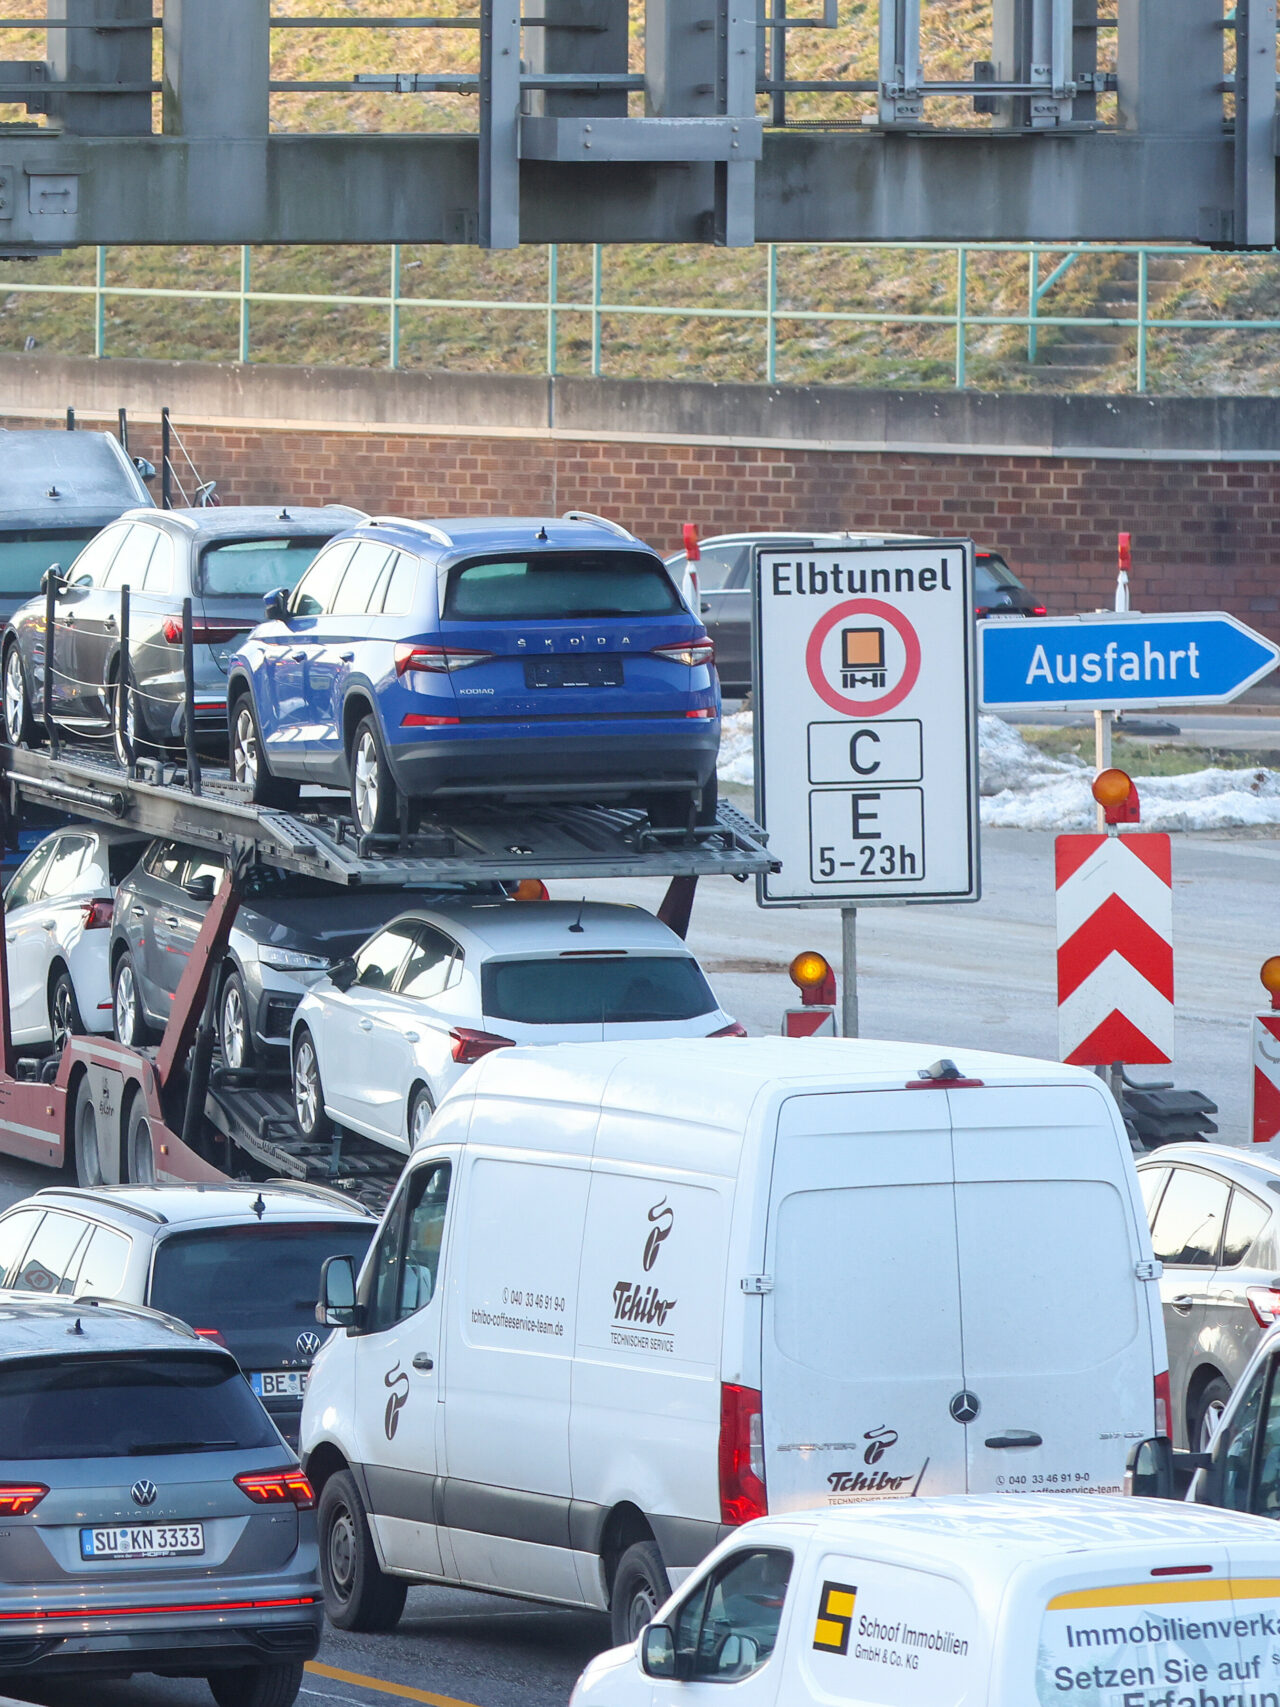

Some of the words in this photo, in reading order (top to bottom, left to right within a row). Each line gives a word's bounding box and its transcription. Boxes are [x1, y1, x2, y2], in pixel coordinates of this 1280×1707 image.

[772, 558, 951, 595] Elbtunnel
[1025, 640, 1200, 685] Ausfahrt
[459, 688, 495, 696] KODIAQ
[849, 729, 881, 775] C
[851, 793, 882, 839] E
[819, 845, 916, 877] 5-23h
[510, 1290, 522, 1305] 040
[525, 1292, 533, 1307] 33
[612, 1281, 678, 1327] Tchibo
[471, 1309, 564, 1336] tchibo-coffeeservice-team.de
[610, 1332, 649, 1349] TECHNISCHER
[650, 1337, 674, 1352] SERVICE
[263, 1375, 287, 1393] BE
[827, 1471, 914, 1492] Tchibo
[1009, 1475, 1027, 1485] 040
[1032, 1474, 1044, 1484] 33
[1046, 1474, 1058, 1483] 46
[1061, 1473, 1071, 1483] 91
[1075, 1472, 1090, 1482] 9-0
[95, 1531, 118, 1551] SU
[131, 1530, 153, 1550] KN
[157, 1527, 200, 1548] 3333
[858, 1615, 901, 1643] Schoof
[901, 1623, 969, 1656] Immobilien
[1066, 1613, 1280, 1648] Immobilienverk
[855, 1643, 881, 1662] GmbH
[882, 1650, 888, 1664] &
[889, 1651, 903, 1667] Co.
[906, 1653, 920, 1670] KG
[1055, 1665, 1154, 1691] Setzen
[1164, 1658, 1208, 1684] Sie
[1218, 1655, 1261, 1681] auf
